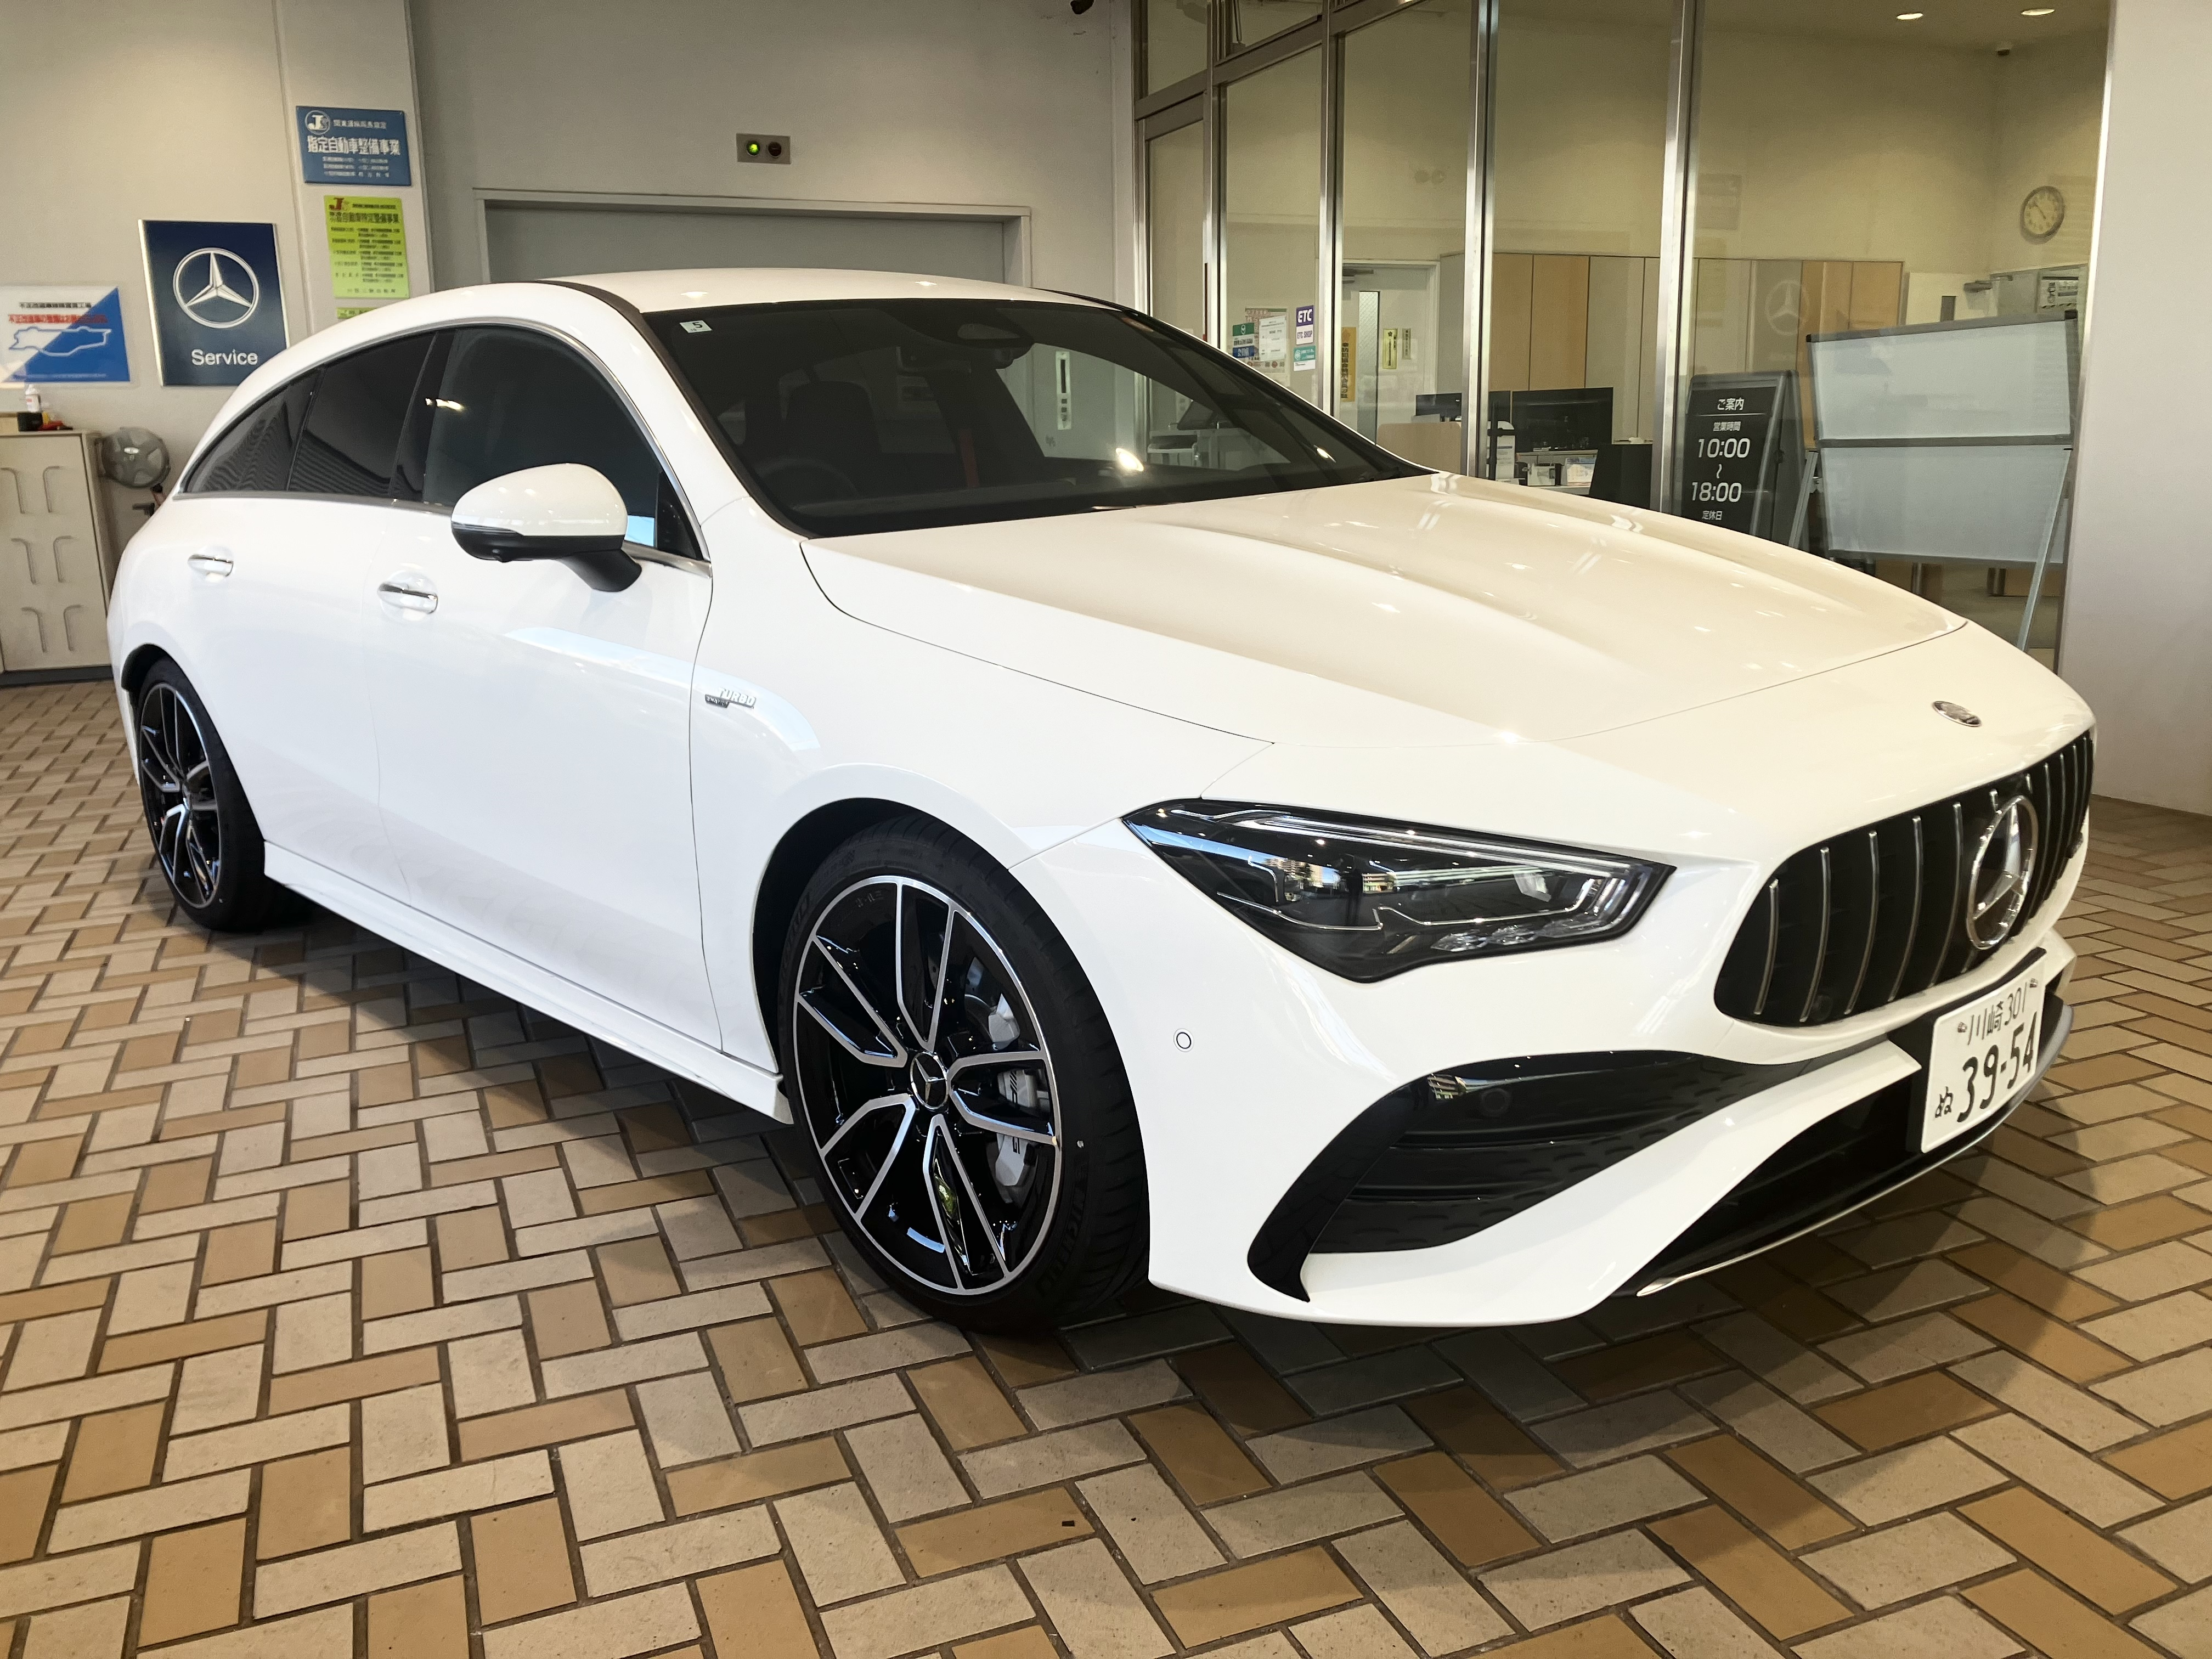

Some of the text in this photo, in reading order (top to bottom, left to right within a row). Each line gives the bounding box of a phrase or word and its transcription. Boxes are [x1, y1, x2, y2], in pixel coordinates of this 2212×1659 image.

[307, 136, 400, 156] 指定自動車整備事業
[1297, 308, 1313, 323] ETC
[191, 348, 258, 366] Service
[1717, 397, 1745, 410] ご案内
[1713, 421, 1741, 431] 営業時間
[1698, 438, 1751, 458] 10:00
[1691, 482, 1742, 503] 18:00
[1702, 510, 1723, 521] 定休日
[719, 687, 757, 707] TURBO
[1967, 981, 2028, 1046] 川崎 301
[1934, 1011, 2038, 1123] ぬ 39-54
